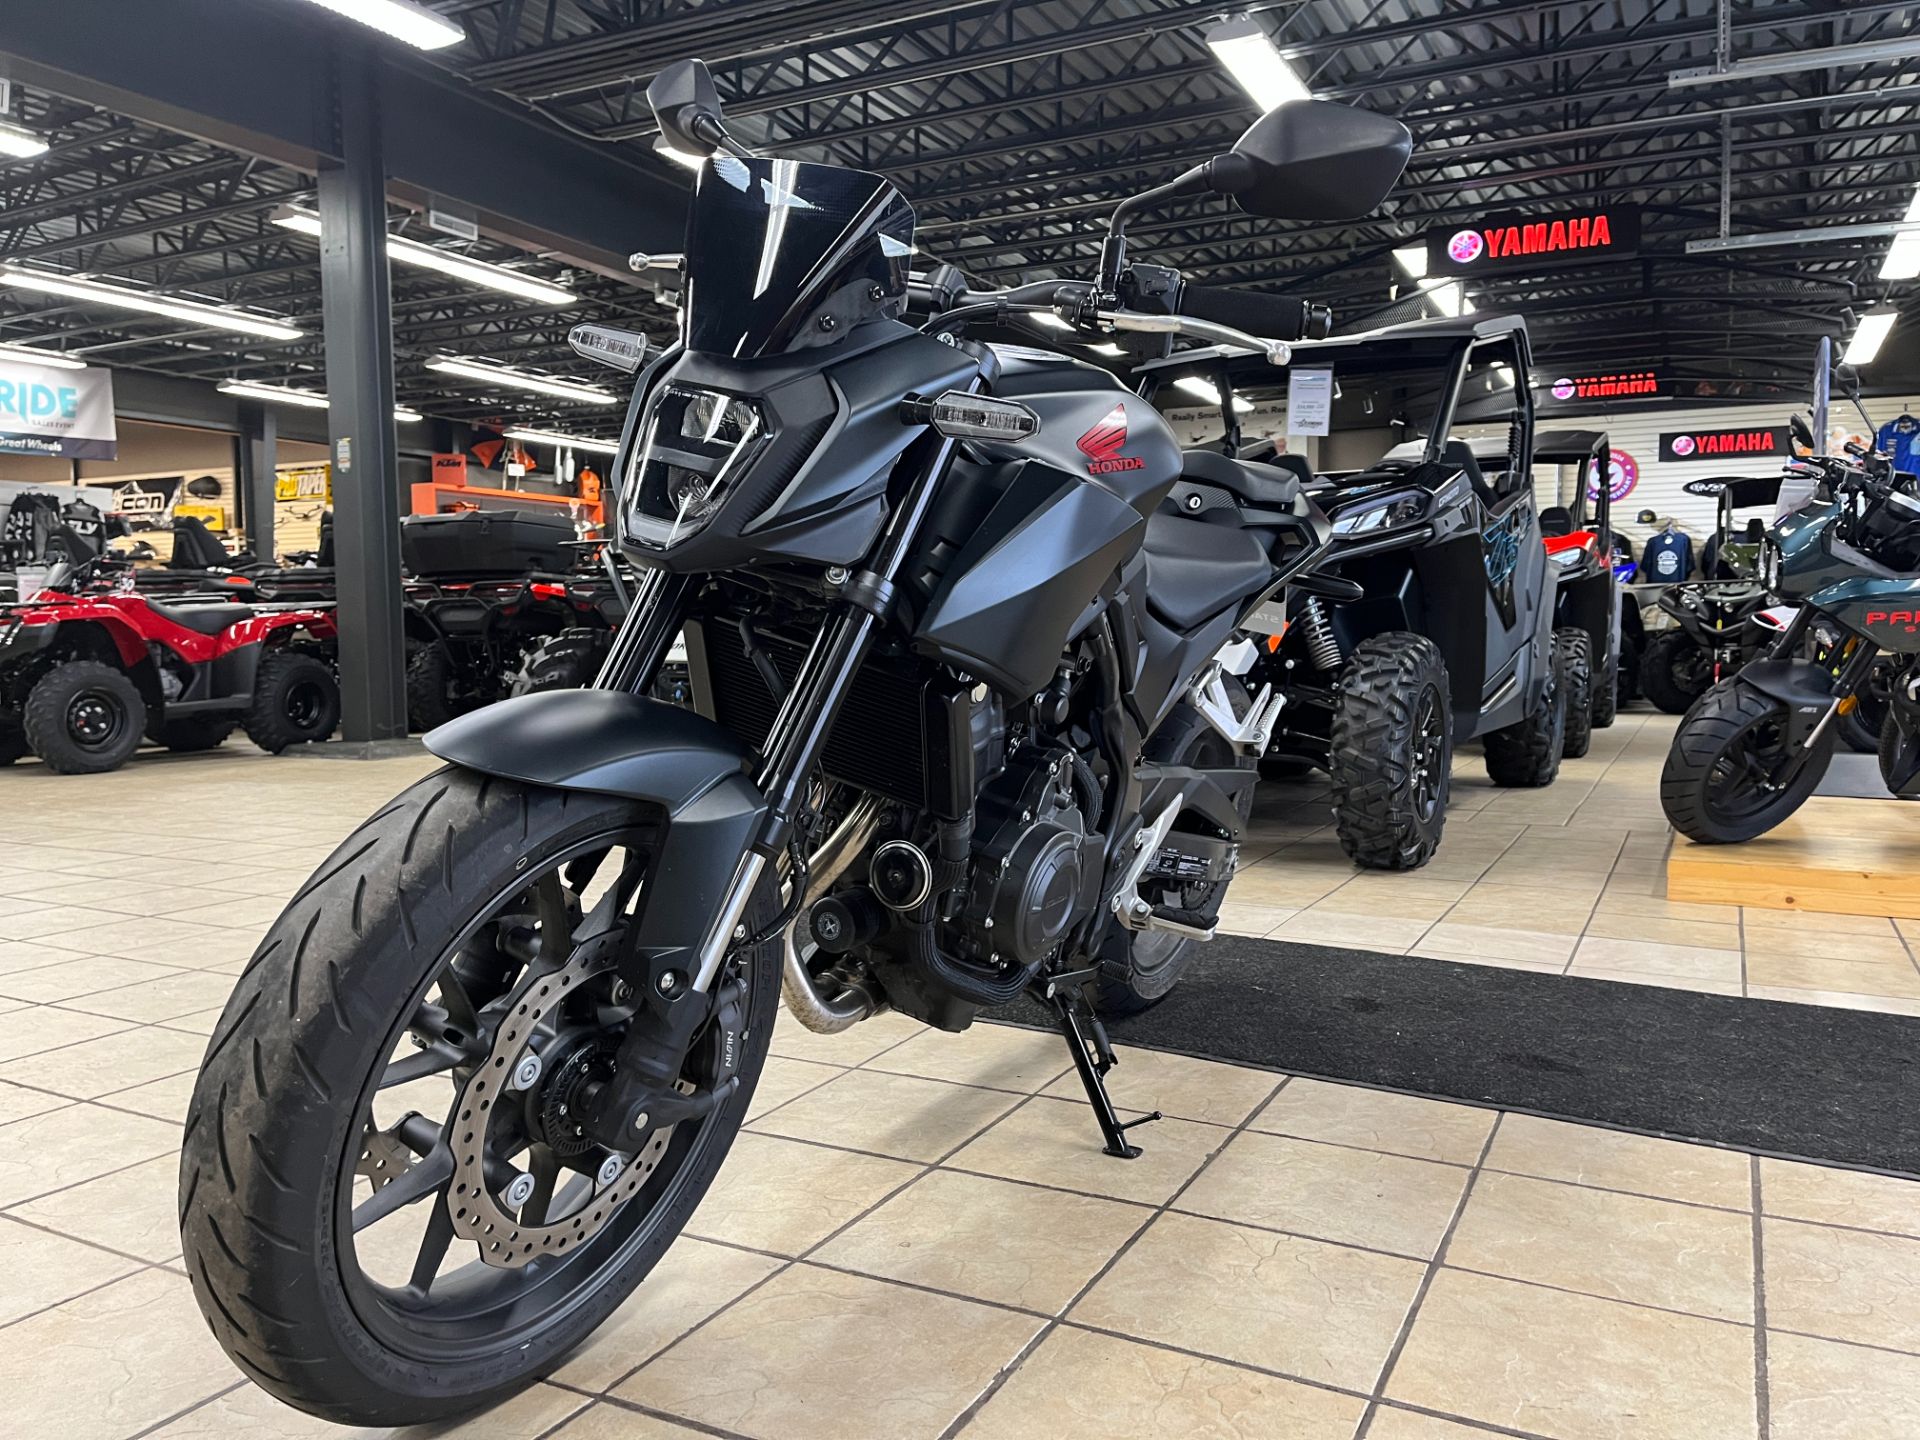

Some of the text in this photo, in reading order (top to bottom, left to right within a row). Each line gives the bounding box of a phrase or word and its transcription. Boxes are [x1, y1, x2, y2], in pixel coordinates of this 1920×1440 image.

[1484, 215, 1611, 258] YAMAHA
[1575, 372, 1658, 397] YAMAHA
[1171, 413, 1196, 422] Really
[27, 439, 63, 452] Wheels
[1695, 432, 1775, 454] YAMAHA
[436, 459, 462, 468] KTM
[1086, 457, 1147, 476] HONDA
